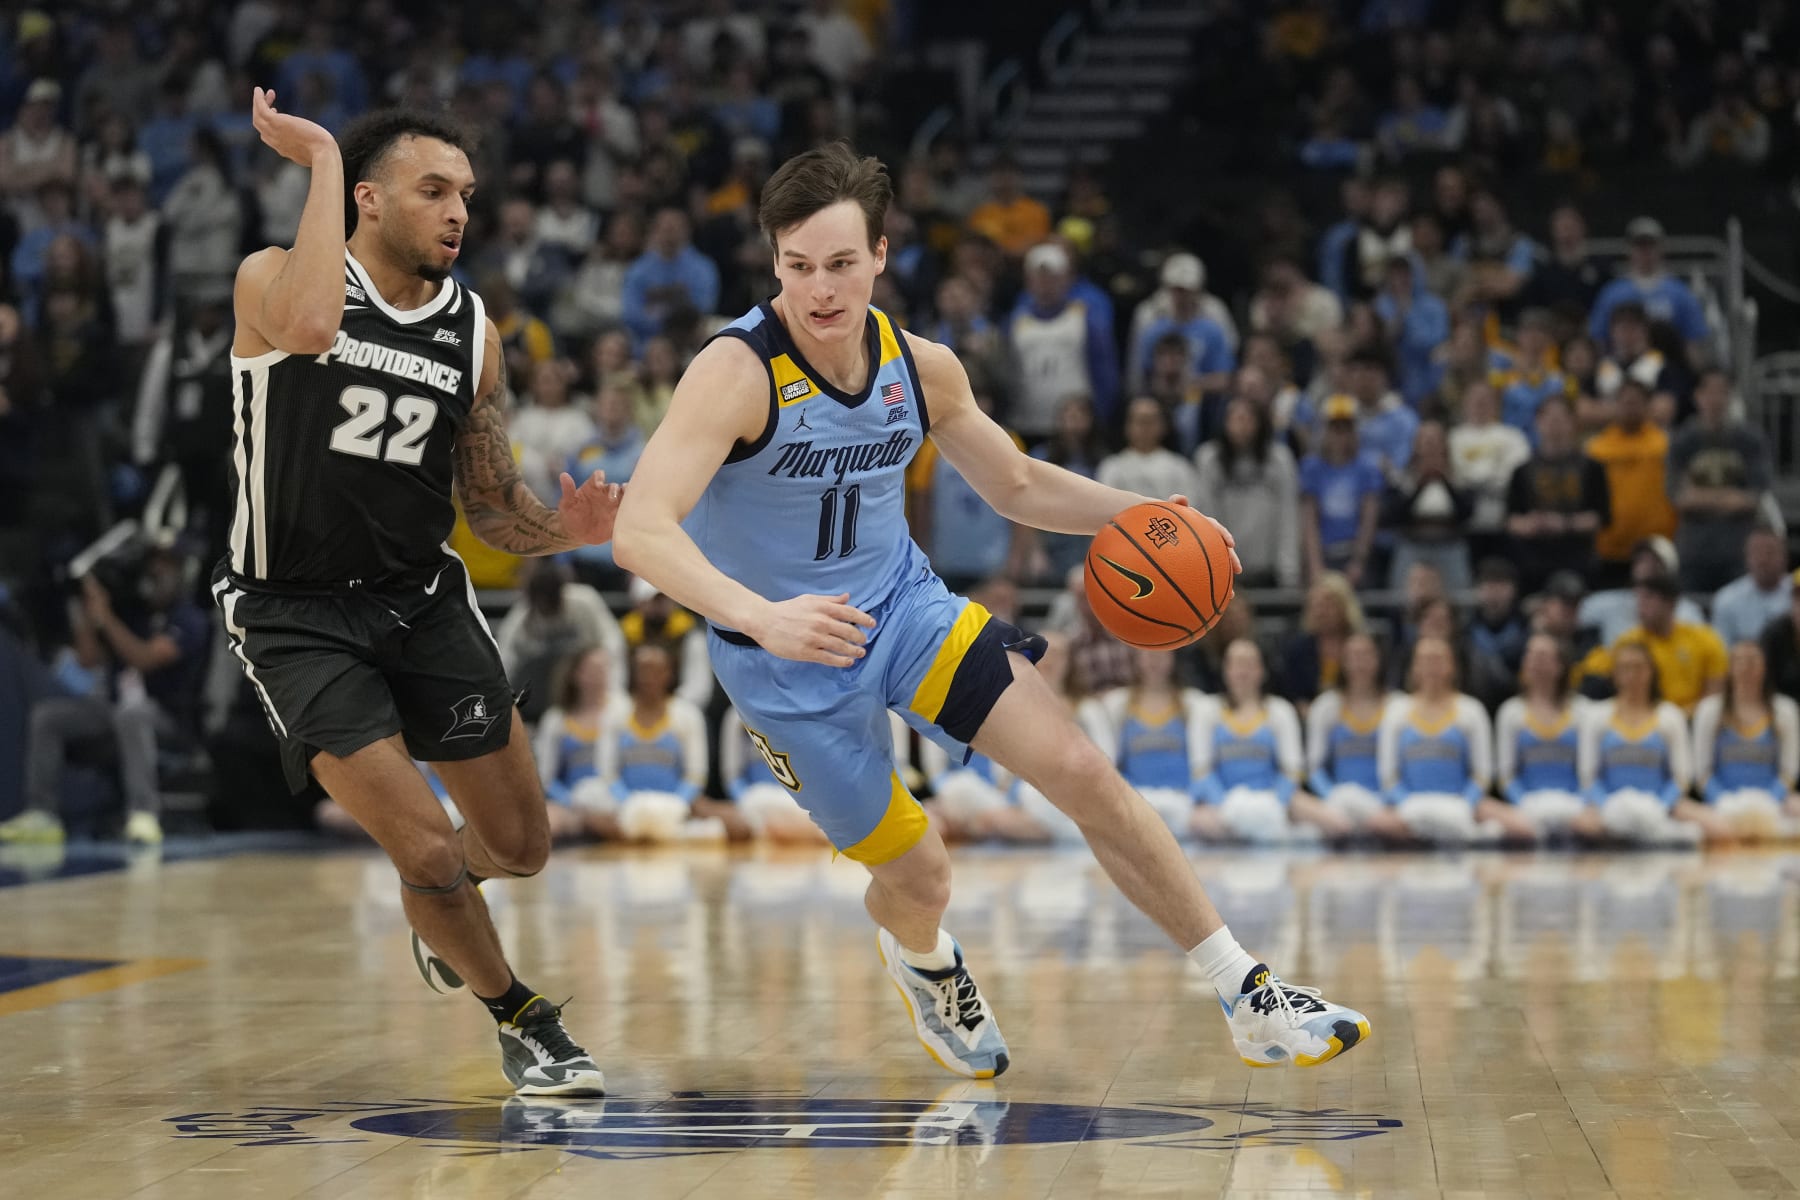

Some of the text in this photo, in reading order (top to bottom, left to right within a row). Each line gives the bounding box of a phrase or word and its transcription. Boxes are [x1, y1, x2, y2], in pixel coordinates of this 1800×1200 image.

[432, 333, 462, 345] EAST
[436, 327, 457, 337] BIG
[314, 329, 463, 395] PROVIDENCE
[329, 384, 439, 466] 22
[885, 410, 909, 423] EAST
[888, 405, 904, 416] BIG
[768, 429, 913, 485] Marquette
[813, 484, 861, 561] 11
